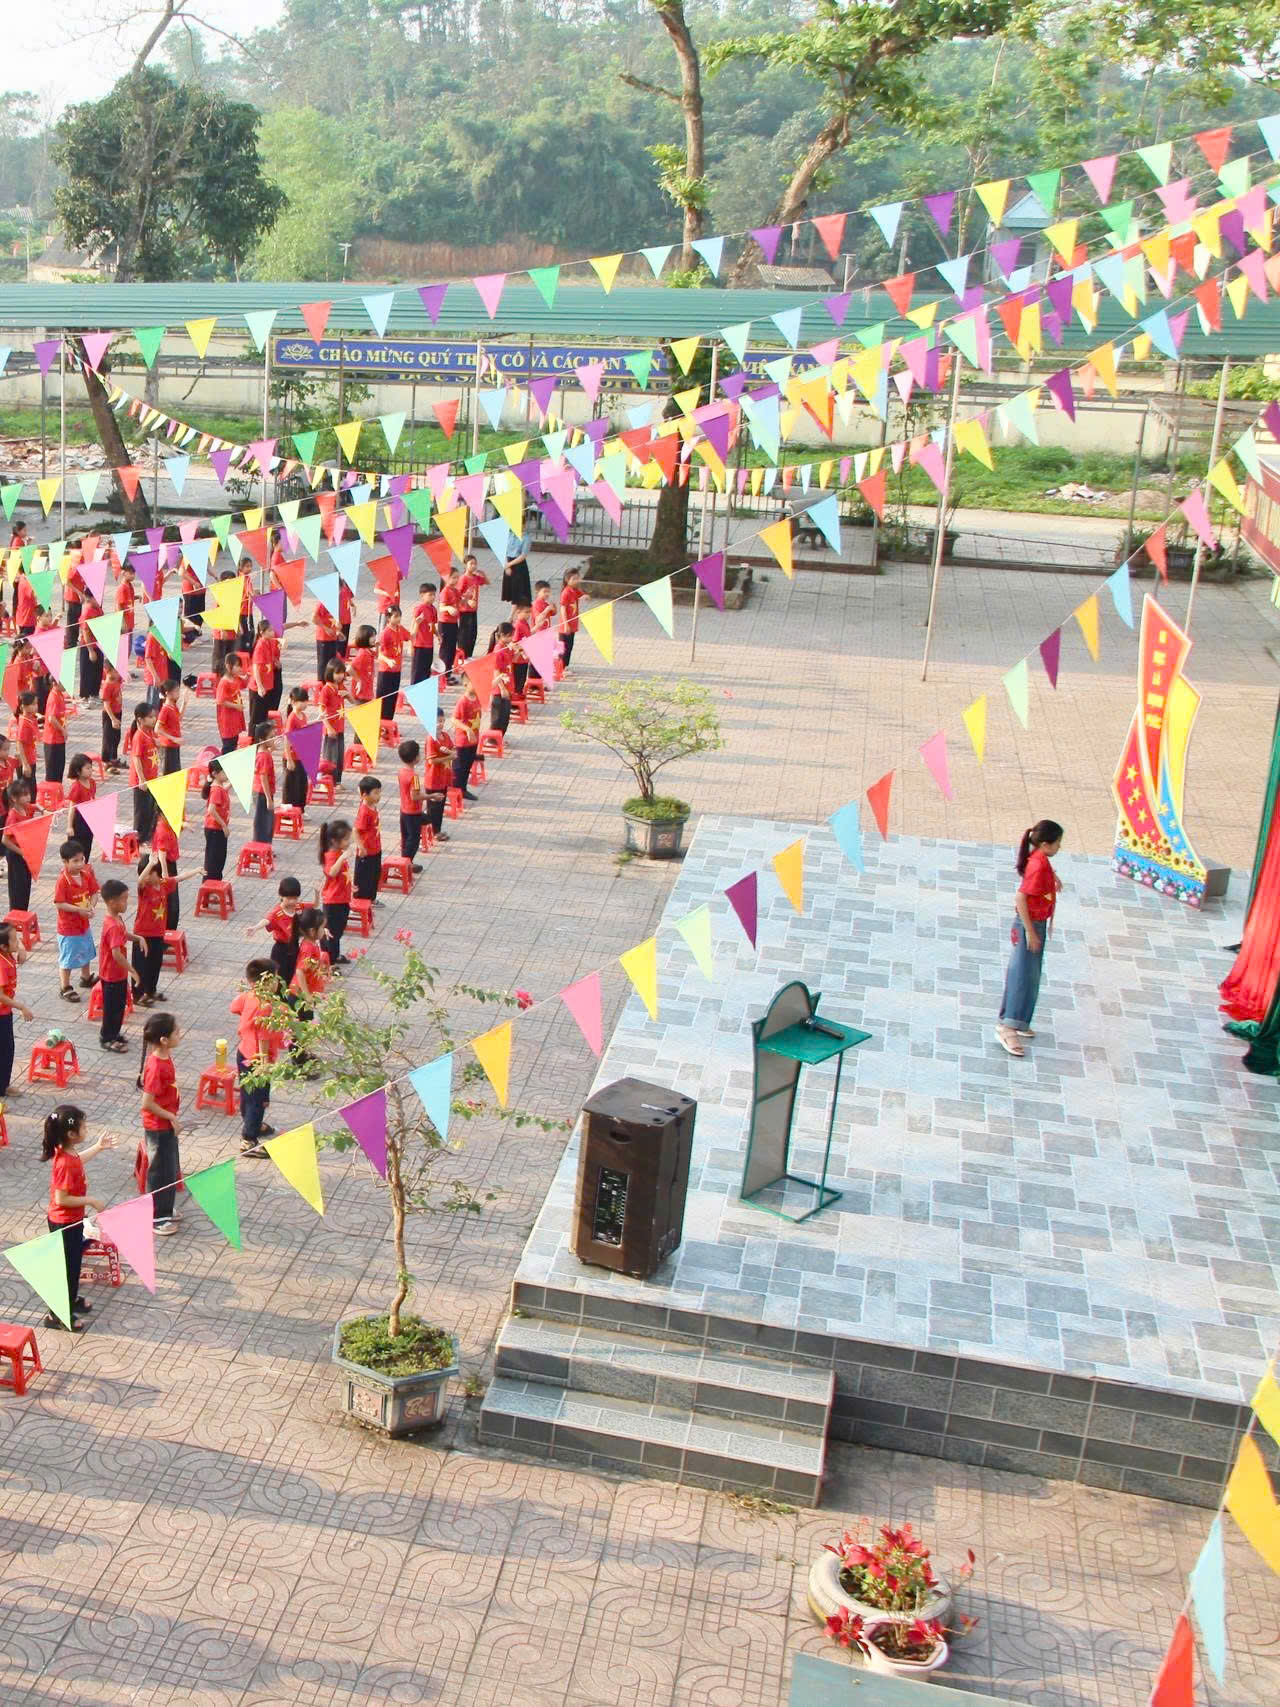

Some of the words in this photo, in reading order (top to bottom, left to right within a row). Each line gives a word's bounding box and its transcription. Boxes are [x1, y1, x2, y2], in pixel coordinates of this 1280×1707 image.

[319, 345, 362, 362] CHÀO
[365, 346, 415, 364] MỪNG
[418, 348, 452, 366] QUÝ
[455, 350, 497, 366] THY
[501, 351, 524, 367] CÔ
[530, 353, 549, 368] VÀ
[552, 351, 584, 369] CÁC
